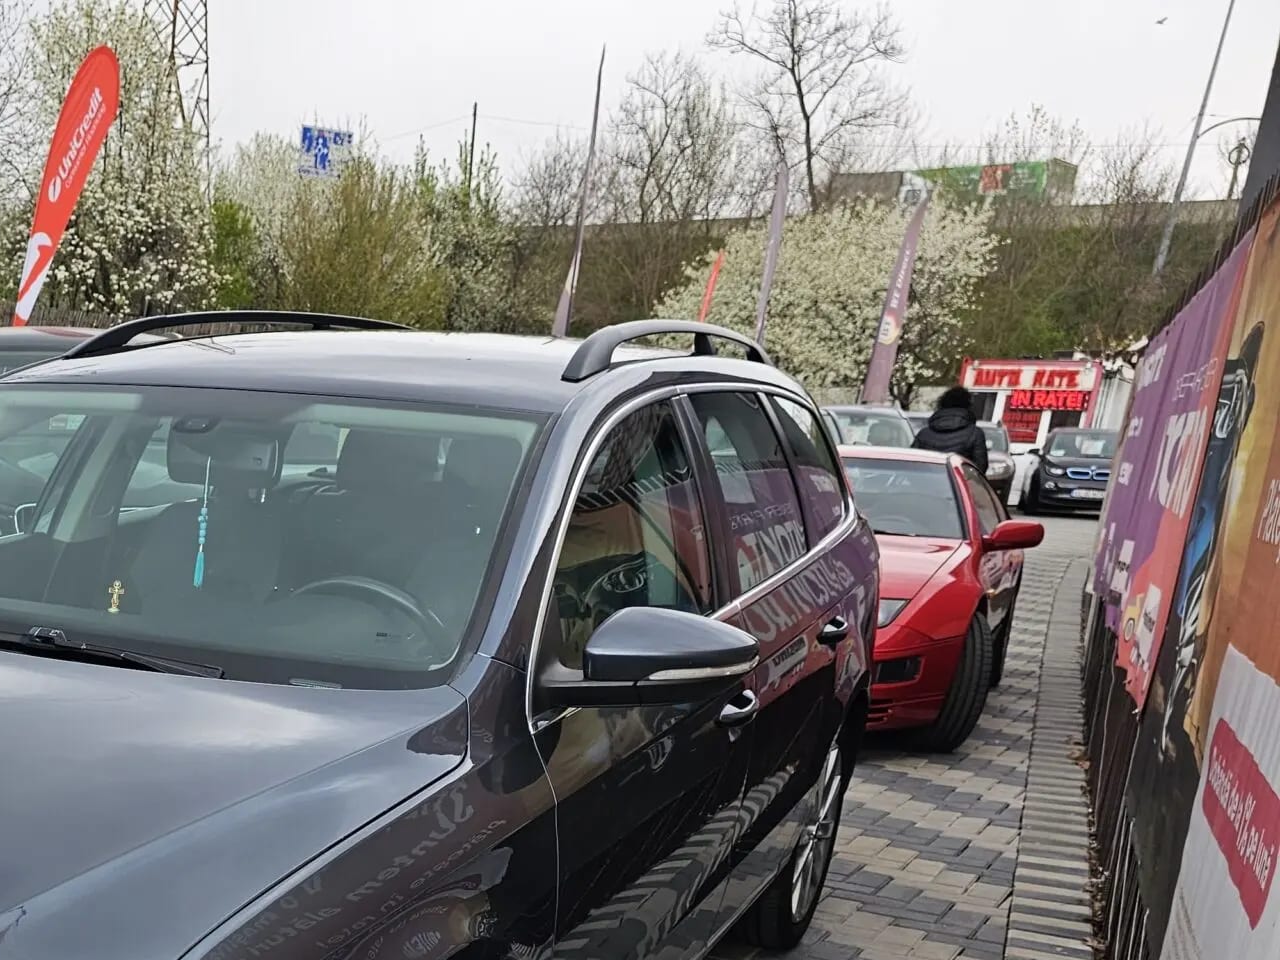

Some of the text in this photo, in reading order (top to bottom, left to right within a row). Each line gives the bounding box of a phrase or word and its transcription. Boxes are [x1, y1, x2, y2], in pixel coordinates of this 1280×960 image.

[58, 87, 103, 180] UniCredit
[1011, 390, 1083, 409] IN RATE!
